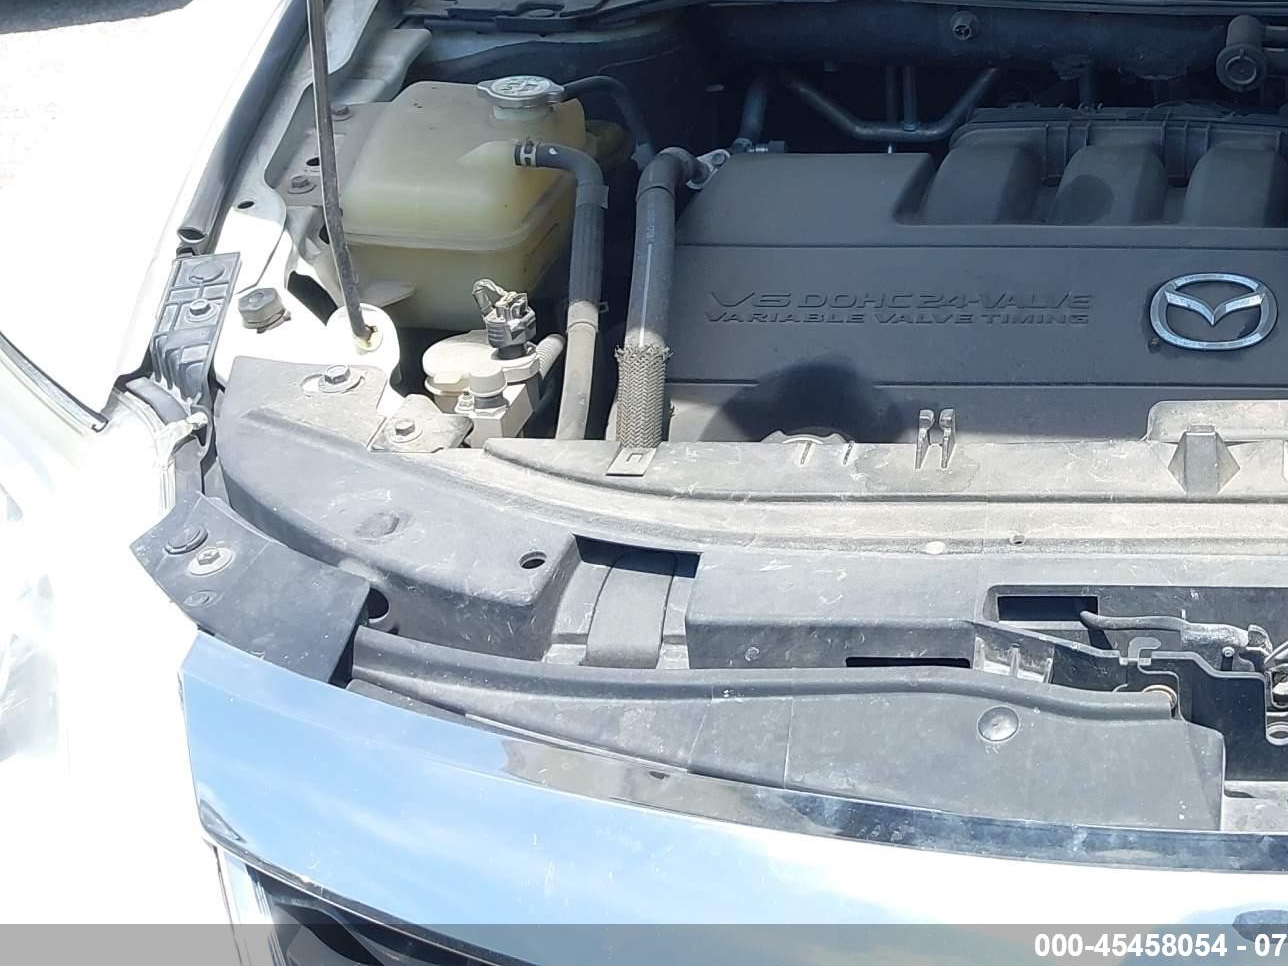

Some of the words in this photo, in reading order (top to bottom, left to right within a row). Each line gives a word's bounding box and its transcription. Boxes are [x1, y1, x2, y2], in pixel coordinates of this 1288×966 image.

[796, 292, 913, 309] DOHC
[705, 312, 865, 324] VARIABLE
[874, 312, 974, 325] VALVE
[981, 314, 1090, 326] TIMING
